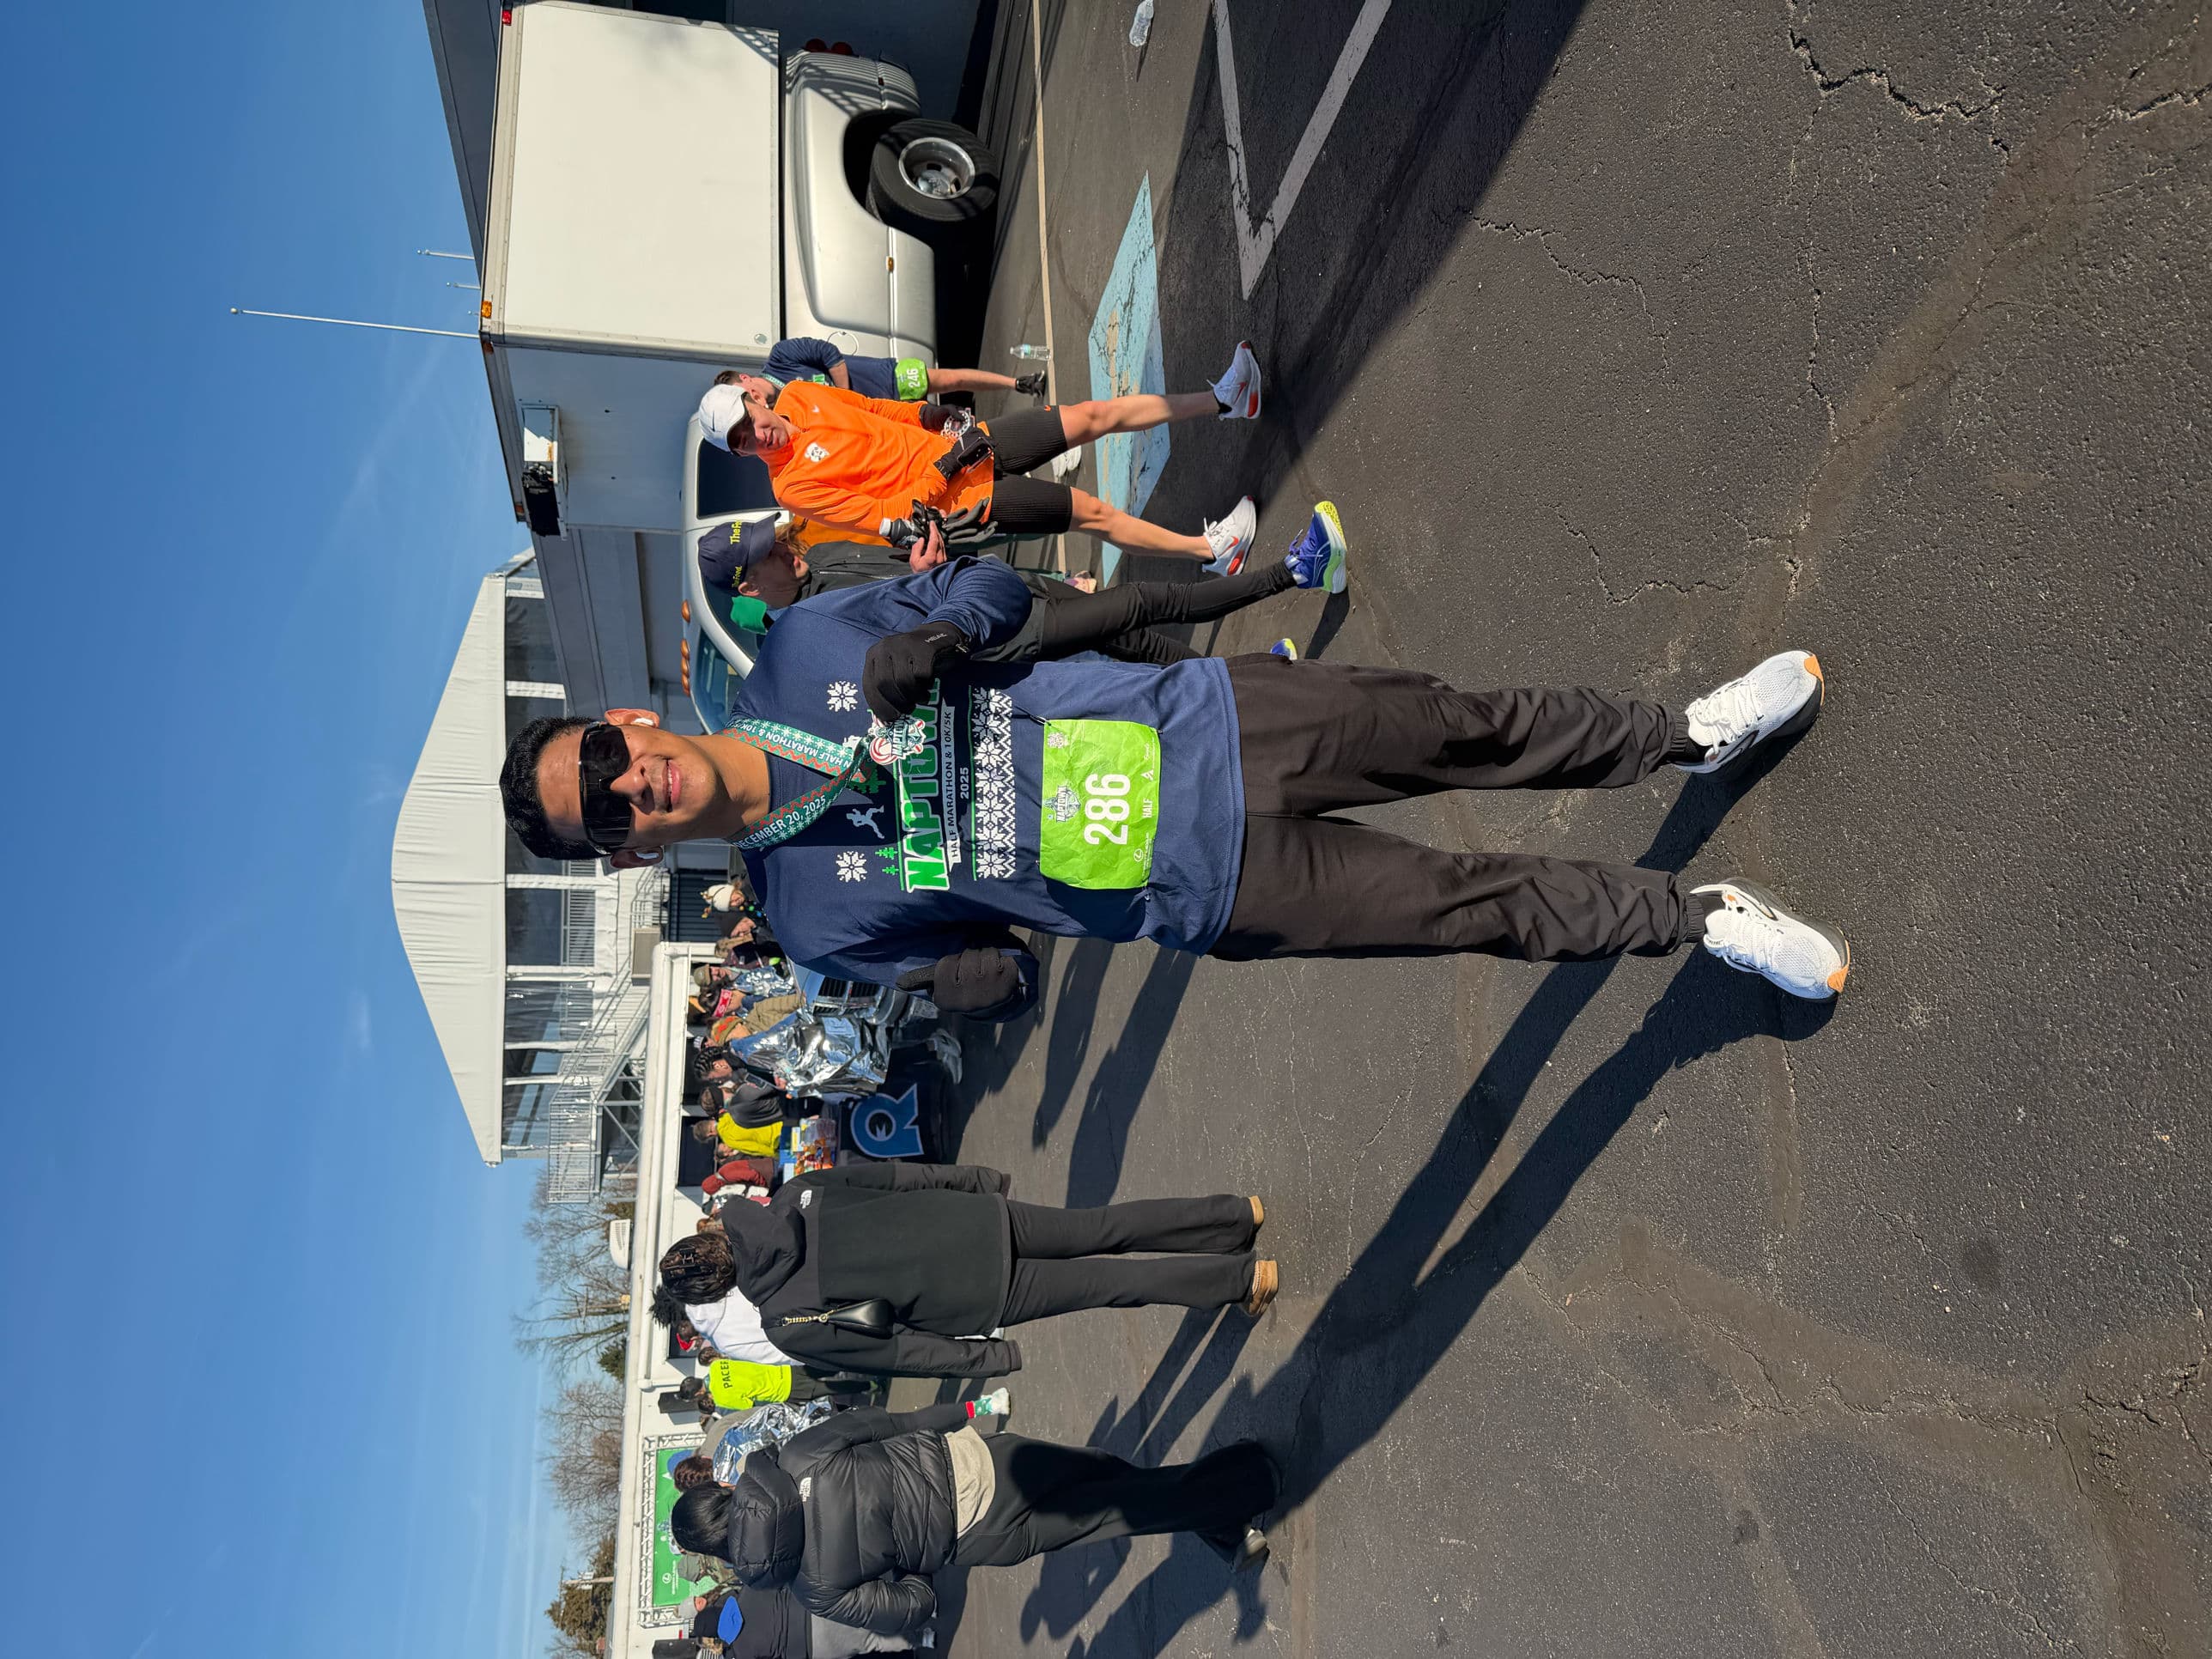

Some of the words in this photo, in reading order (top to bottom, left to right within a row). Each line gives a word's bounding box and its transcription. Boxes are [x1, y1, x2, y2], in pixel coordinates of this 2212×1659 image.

[906, 368, 921, 388] 246
[758, 728, 766, 737] &
[766, 731, 819, 754] MARATHON
[943, 711, 952, 749] 10K/5K
[819, 751, 843, 766] HALF
[945, 750, 953, 759] &
[899, 678, 950, 893] NAPTOW
[945, 761, 955, 827] MARATHON
[960, 767, 970, 799] 2025
[1056, 786, 1066, 822] NAPTOWN
[1084, 773, 1131, 845] 286
[1142, 798, 1152, 818] HALF
[733, 819, 787, 847] DECEMBER
[785, 811, 804, 824] 20,
[802, 794, 826, 815] 2025
[948, 830, 958, 857] HALF
